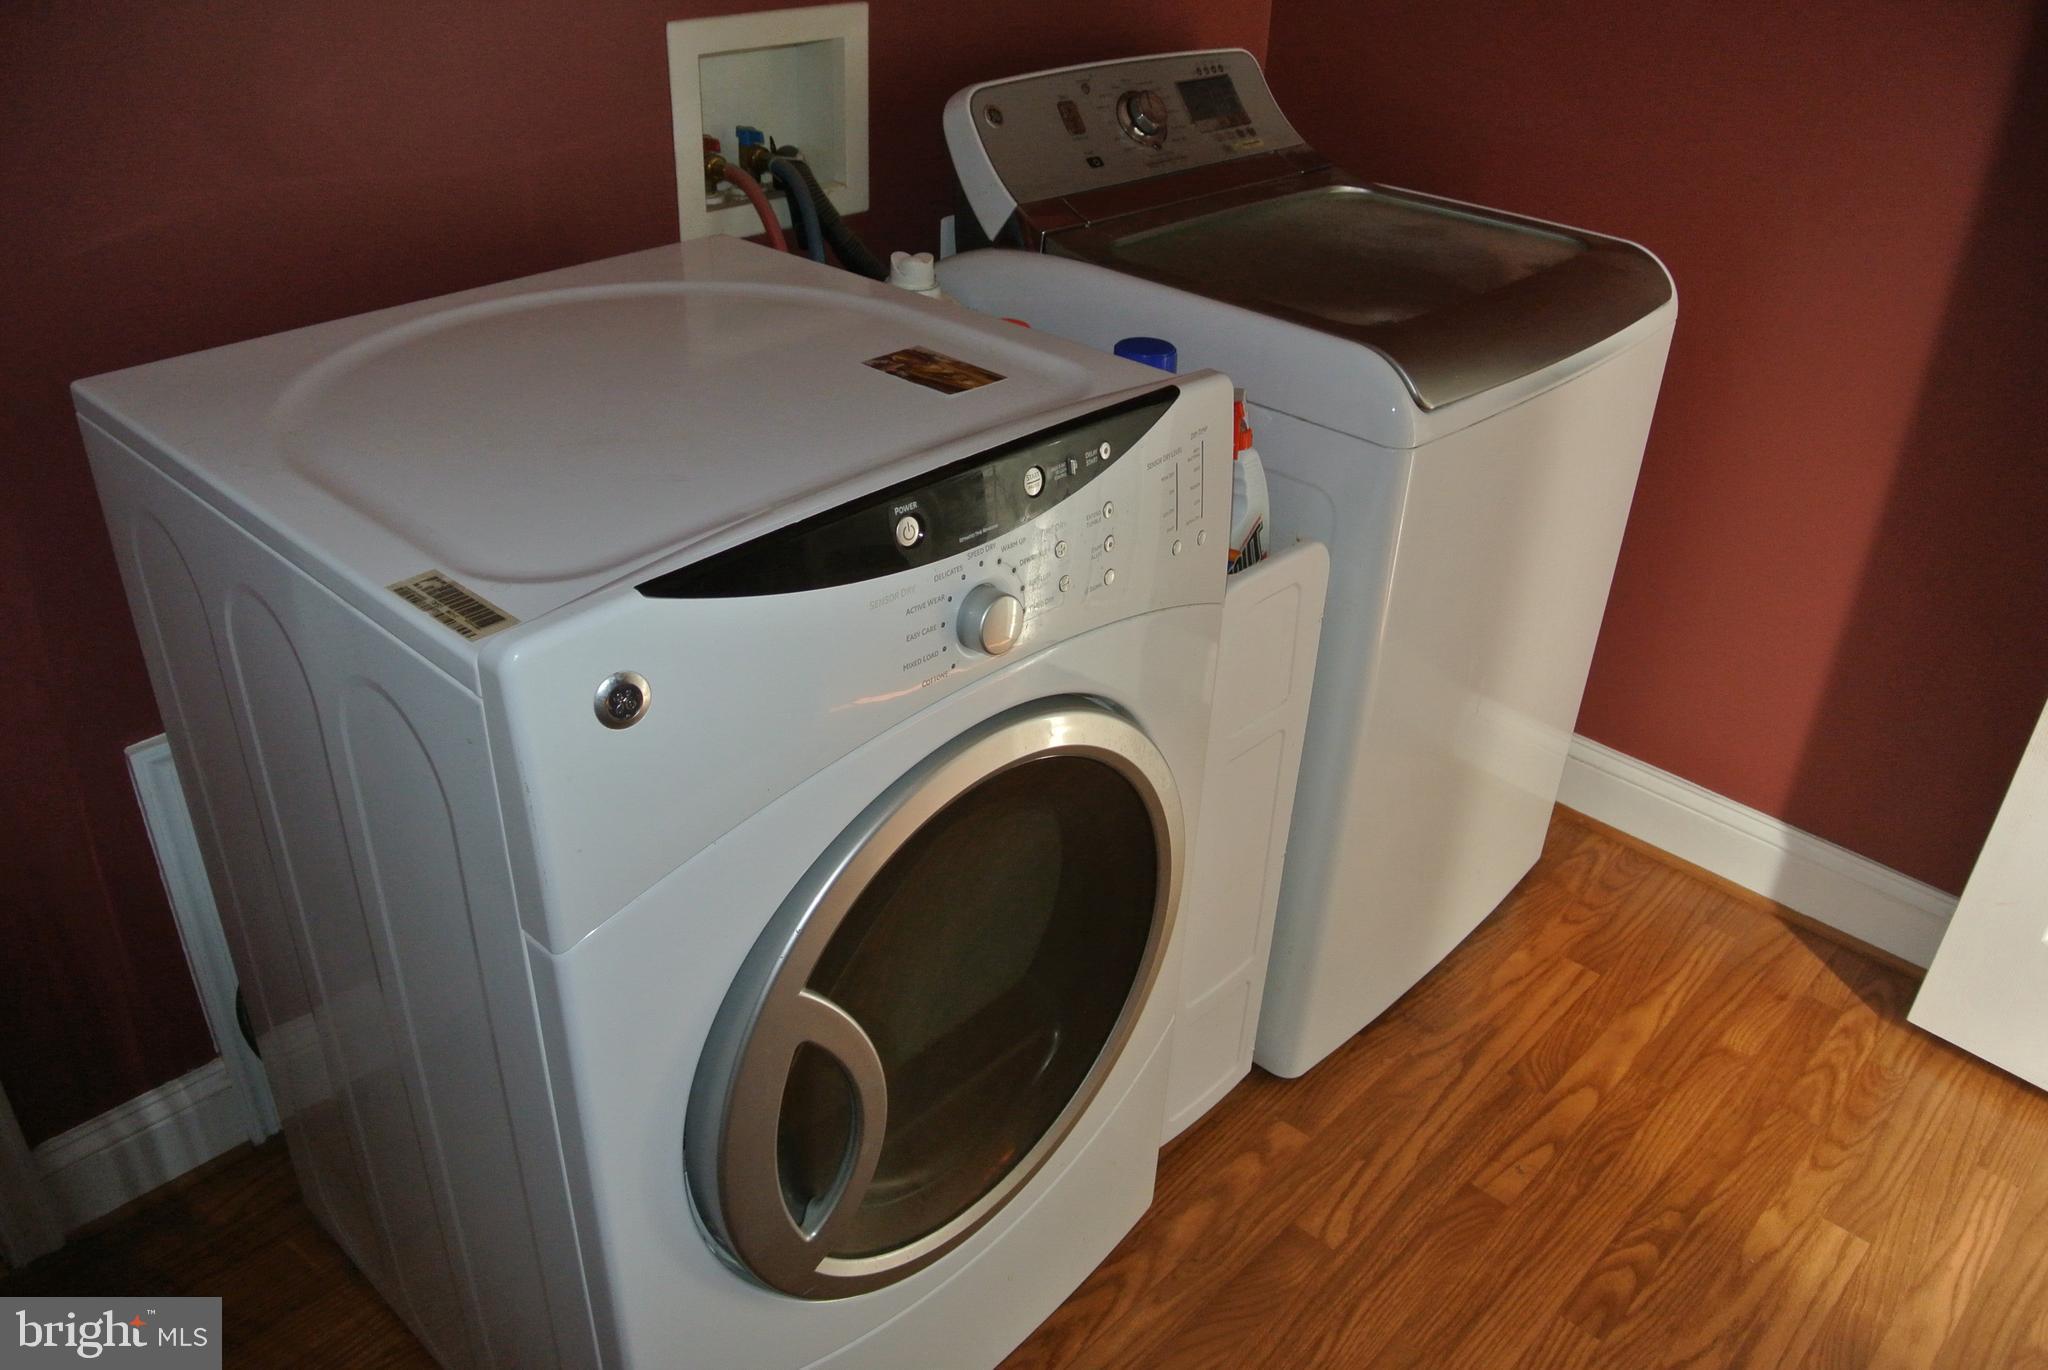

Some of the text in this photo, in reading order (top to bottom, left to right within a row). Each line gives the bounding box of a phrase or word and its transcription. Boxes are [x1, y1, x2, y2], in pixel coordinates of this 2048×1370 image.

[894, 501, 918, 516] POWER
[967, 547, 985, 560] SPEED
[933, 565, 964, 582] DELICATES
[869, 591, 900, 610] SENSOR
[905, 594, 945, 616] ACTIVE WEAR
[905, 624, 938, 642] EASY CARE
[902, 650, 939, 672] MIXED LOAD
[921, 670, 949, 688] COTTONS
